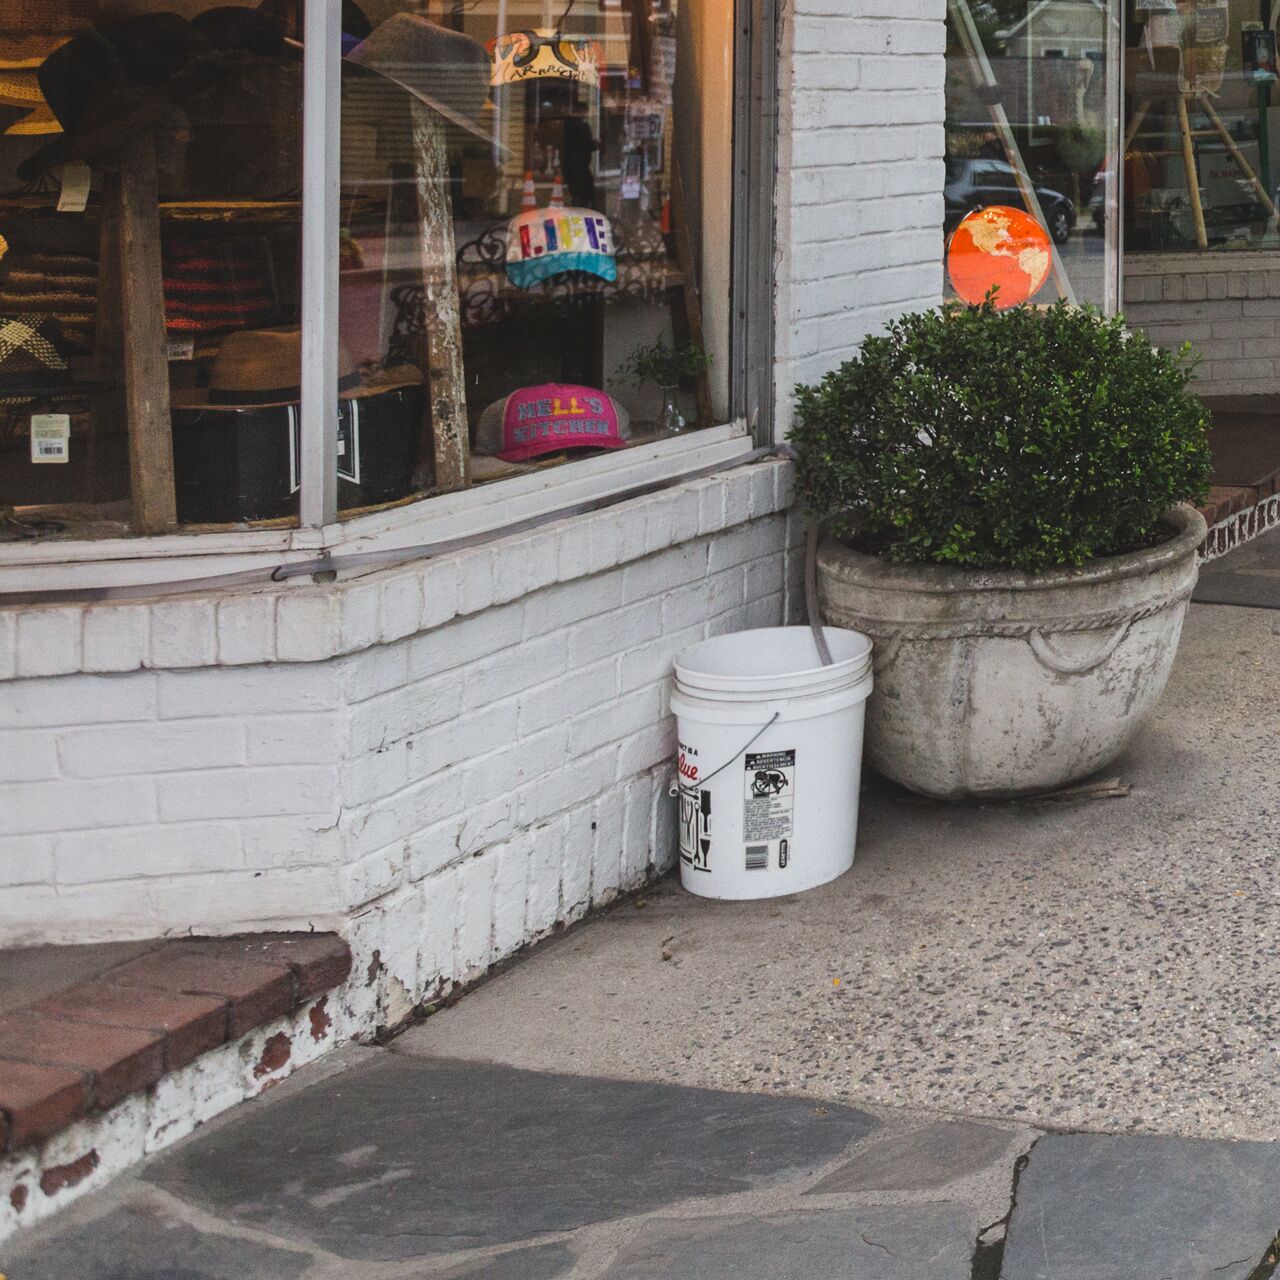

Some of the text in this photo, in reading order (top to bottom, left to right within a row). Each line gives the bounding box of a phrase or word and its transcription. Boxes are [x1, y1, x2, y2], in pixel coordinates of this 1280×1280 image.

[519, 216, 607, 258] LIFE
[518, 397, 604, 421] HELL'S
[513, 419, 609, 443] KITCHEN
